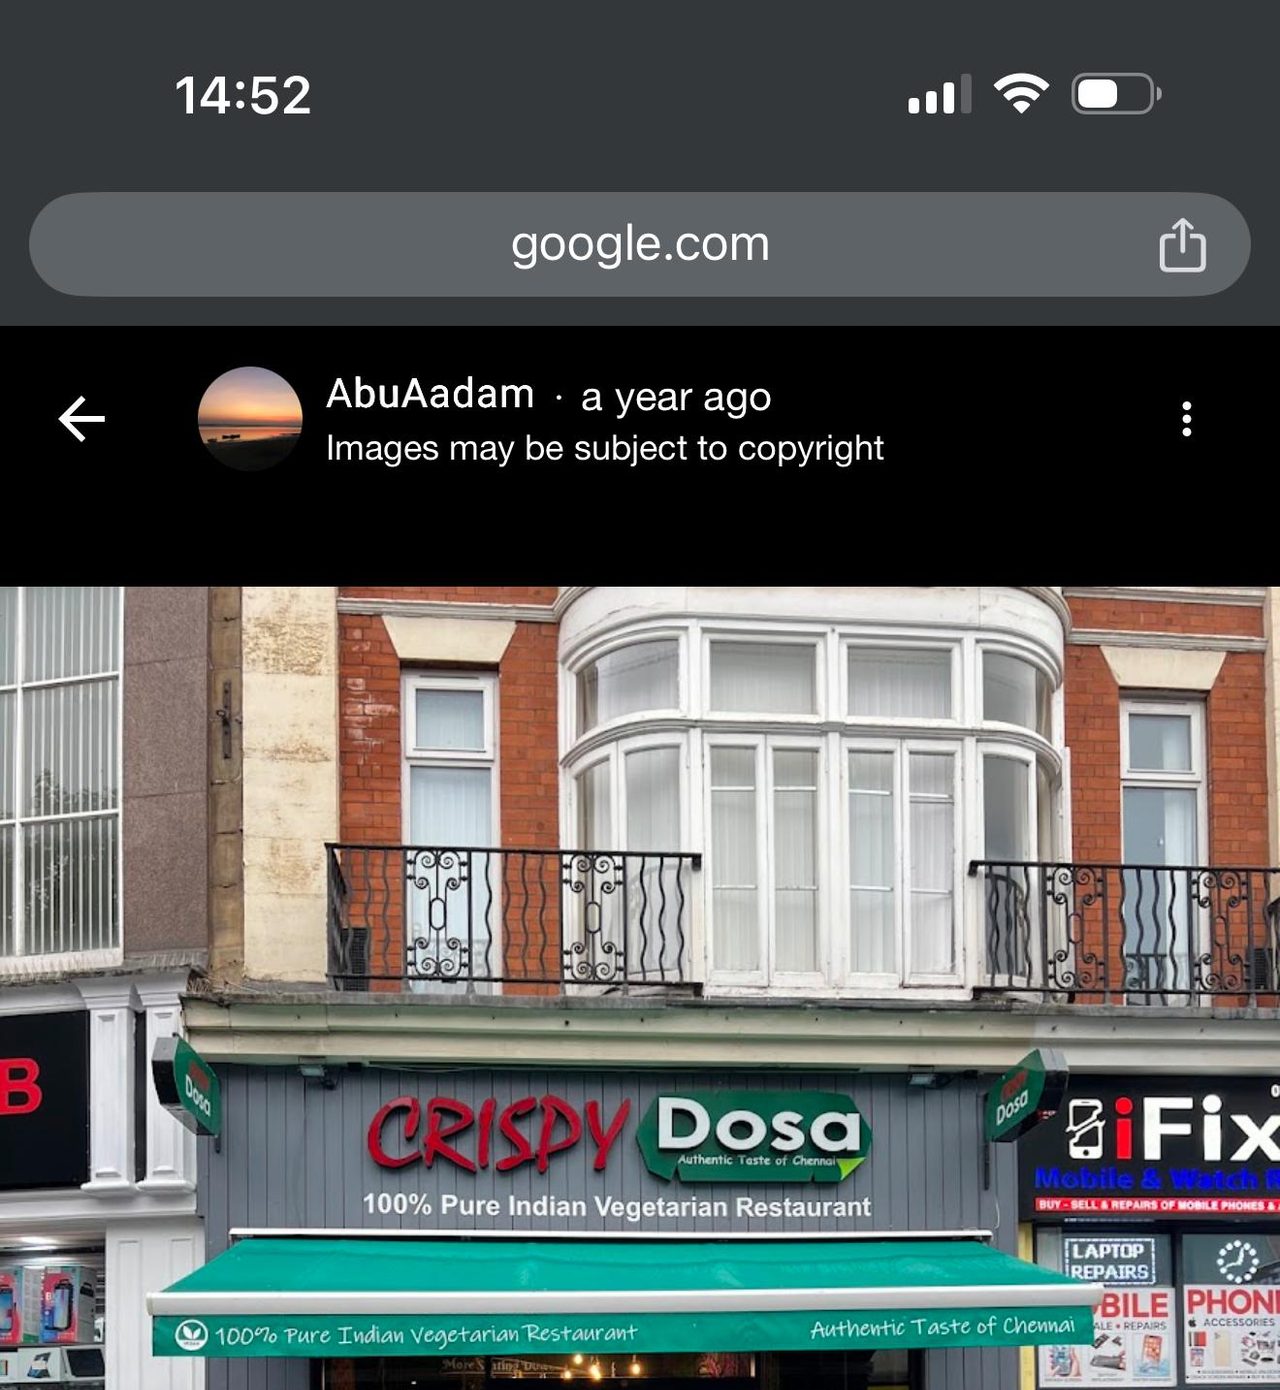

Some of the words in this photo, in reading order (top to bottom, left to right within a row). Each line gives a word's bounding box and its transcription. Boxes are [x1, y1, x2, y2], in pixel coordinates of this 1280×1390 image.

[185, 1073, 211, 1117] Dosa
[996, 1089, 1029, 1126] Dosa
[367, 1095, 631, 1174] CRISPY
[657, 1097, 861, 1152] Dosa
[678, 1153, 736, 1166] Authentic
[739, 1154, 772, 1166] Taste
[775, 1154, 788, 1166] of
[792, 1153, 836, 1166] Chennai
[1034, 1166, 1133, 1191] Mobile
[1140, 1167, 1162, 1191] &
[1170, 1167, 1259, 1191] Watch
[363, 1192, 433, 1216] 100%
[441, 1193, 501, 1217] Pure
[508, 1194, 587, 1217] Indian
[593, 1195, 728, 1222] Vegetarian
[736, 1196, 872, 1218] Restaurant
[1039, 1199, 1061, 1210] BUY
[1070, 1199, 1098, 1211] SELL
[1100, 1200, 1109, 1211] &
[1111, 1199, 1158, 1211] REPAIRS
[1160, 1200, 1176, 1211] OF
[1177, 1200, 1219, 1212] MOBILE
[1220, 1201, 1265, 1212] PHONES
[1072, 1243, 1144, 1260] LAPTOP
[1070, 1264, 1149, 1280] REPAIRS
[1093, 1292, 1168, 1319] BILE
[1186, 1288, 1280, 1315] PHON
[810, 1319, 906, 1340] Authentic
[910, 1318, 971, 1336] Taste
[976, 1315, 998, 1338] of
[1003, 1315, 1076, 1335] Chennai
[1123, 1320, 1167, 1332] REPAIRS
[1203, 1317, 1276, 1328] ACCESSORIES
[215, 1326, 278, 1346] 100%
[283, 1327, 331, 1345] Pure
[338, 1325, 404, 1345] Indian
[410, 1323, 520, 1348] Vegetarian
[521, 1323, 639, 1343] Restaurant
